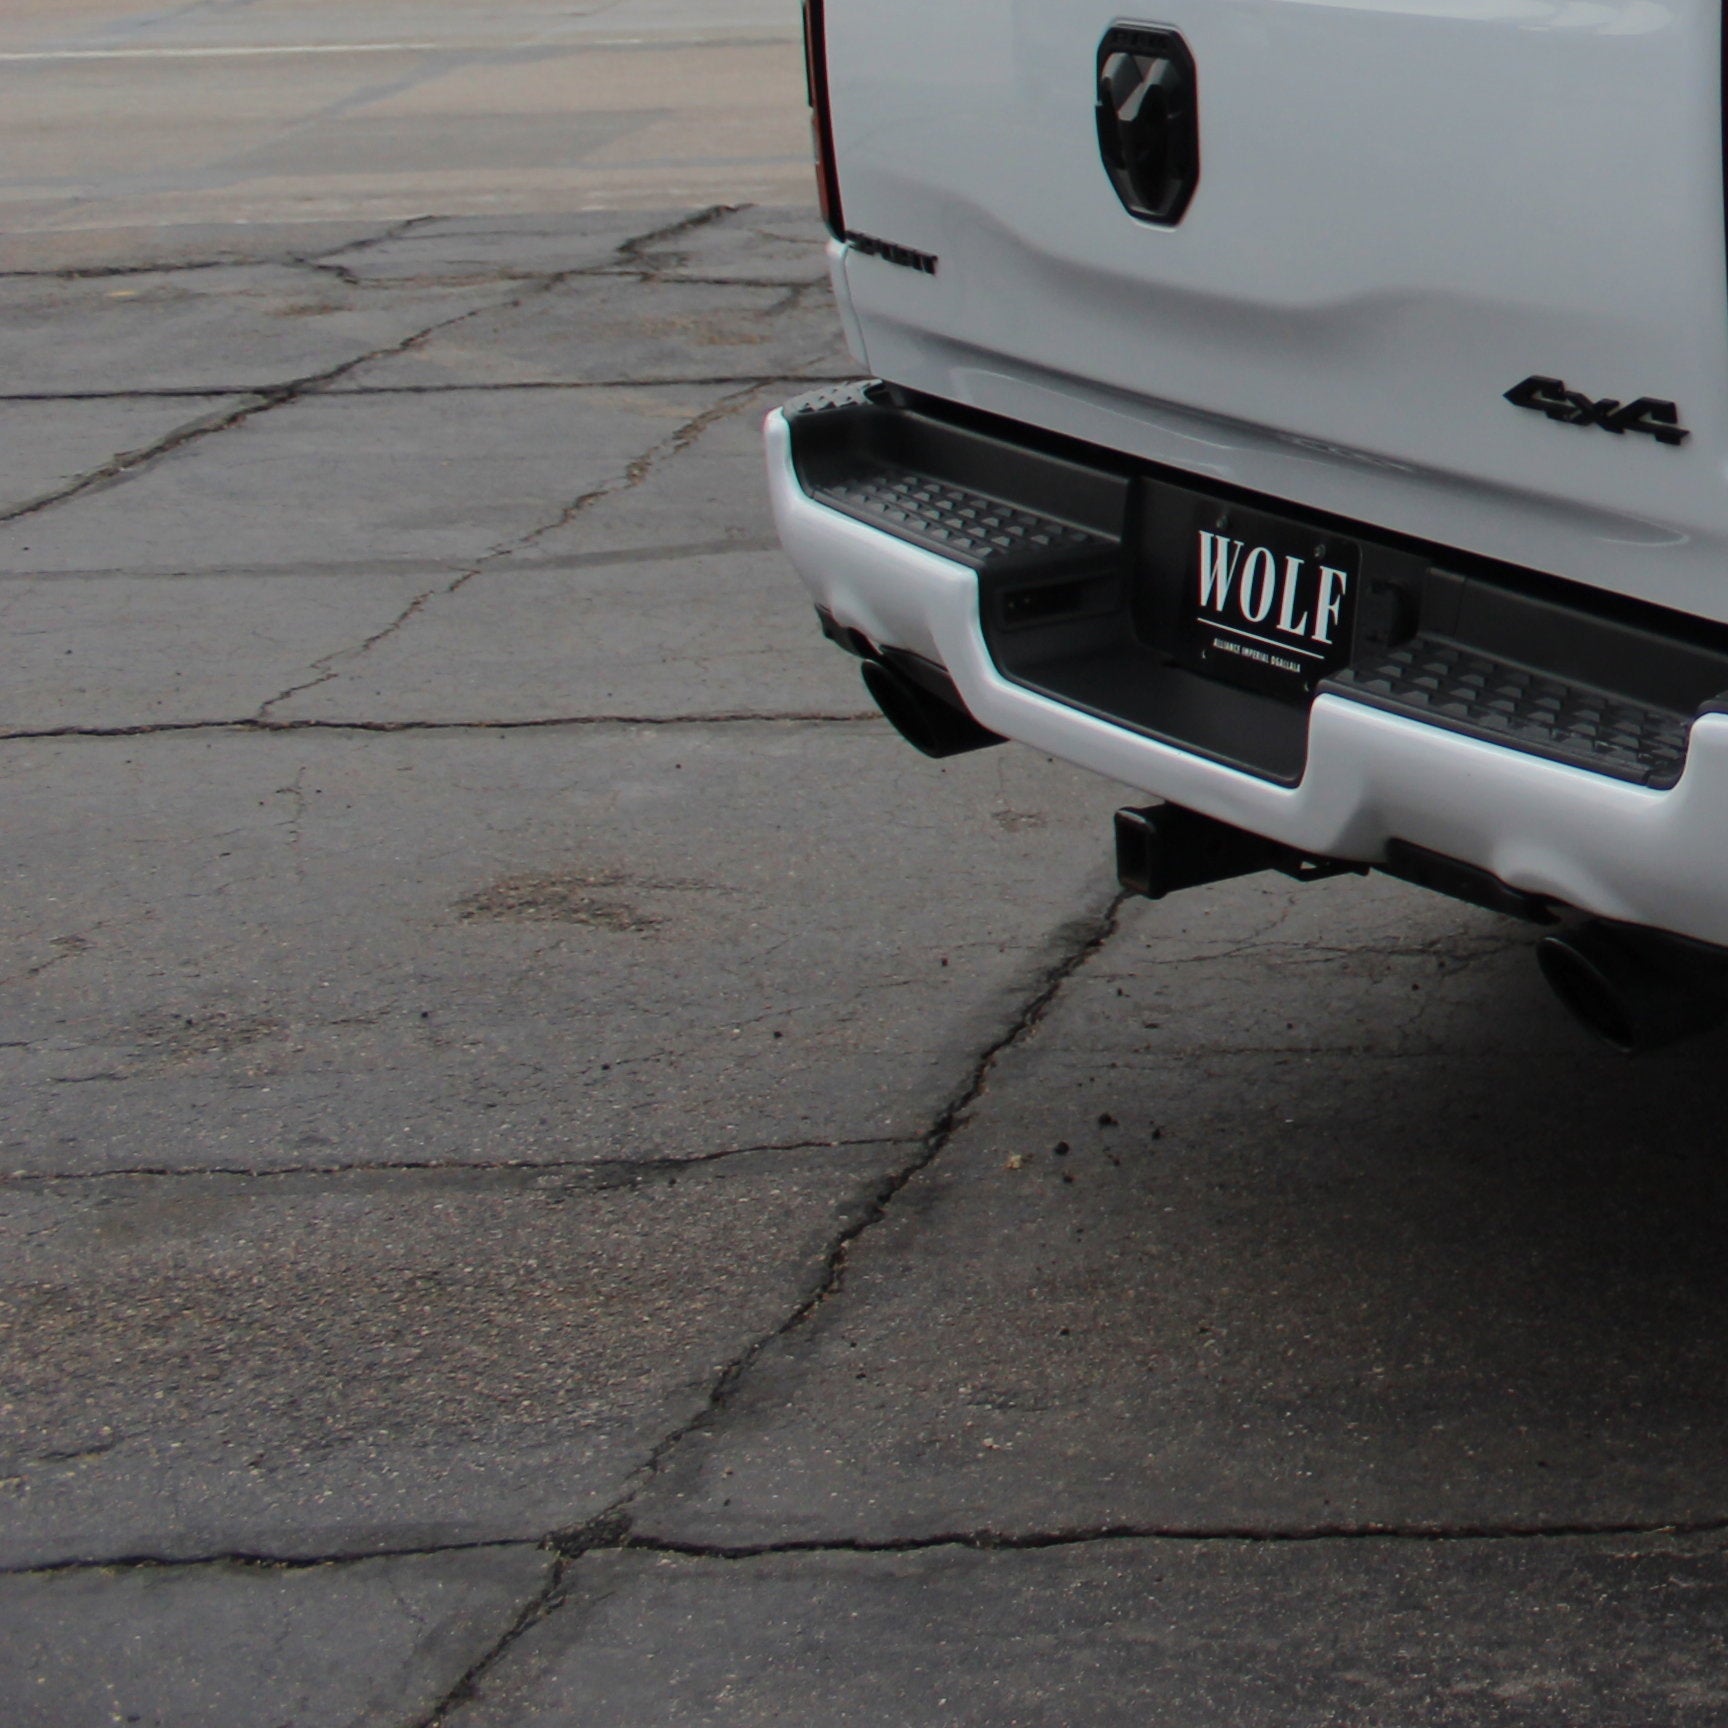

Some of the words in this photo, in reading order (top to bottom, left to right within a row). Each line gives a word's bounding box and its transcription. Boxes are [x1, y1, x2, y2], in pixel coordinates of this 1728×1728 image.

[1198, 530, 1347, 645] WOLF
[1213, 638, 1240, 655] ALLIANCE
[1241, 647, 1269, 664] IMPERIAL
[1270, 655, 1301, 673] OGALLALA
